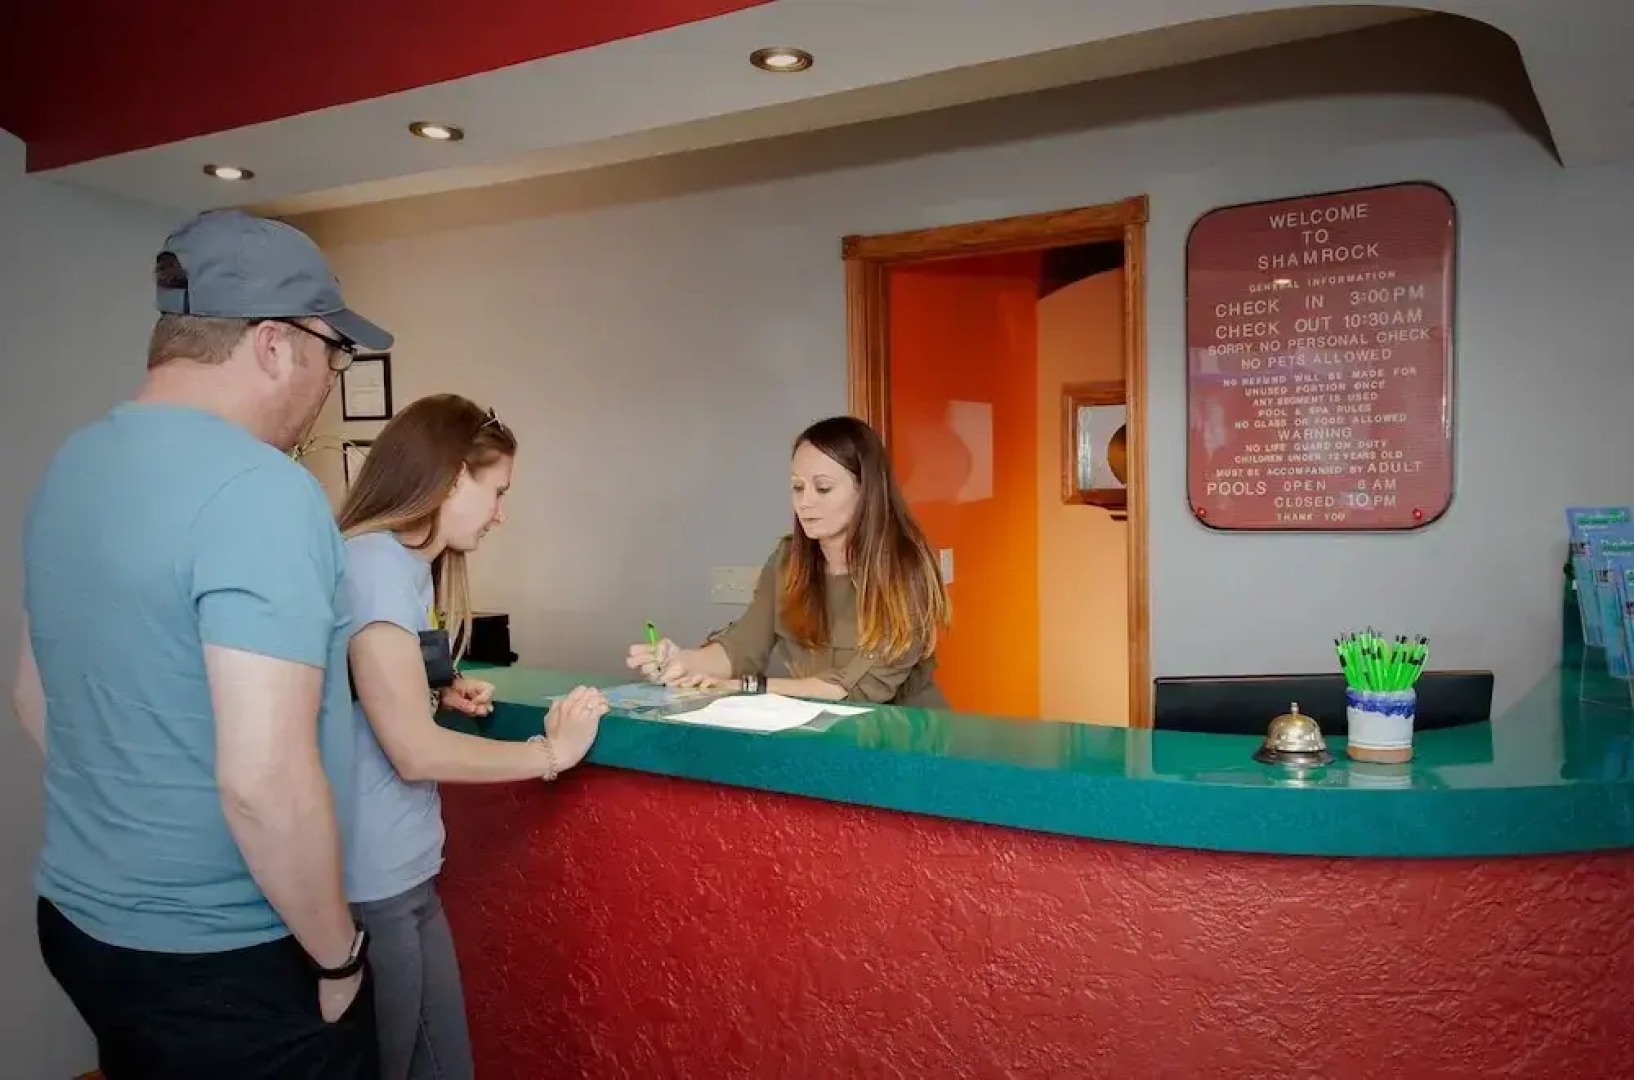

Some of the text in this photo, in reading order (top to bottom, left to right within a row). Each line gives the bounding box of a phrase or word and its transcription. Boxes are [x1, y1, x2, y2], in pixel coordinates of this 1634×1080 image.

[1270, 204, 1368, 229] WELCOME
[1302, 229, 1329, 244] TO
[1257, 244, 1379, 269] SHAMROCK
[1308, 271, 1396, 287] INFORMATION
[1216, 299, 1279, 318] CHECK
[1305, 295, 1324, 309] IN
[1216, 321, 1279, 339] CHECK
[1295, 316, 1332, 333] OUT
[1209, 328, 1430, 356] SORRY NO PERSONAL CHECK
[1241, 348, 1391, 370] NO PETS ALLOWED
[1223, 367, 1416, 387] NO REFUND WILL BE MADE FOR
[1245, 380, 1385, 396] UNUSED PORTION ONCE
[1253, 392, 1378, 407] ANY SEGMENT IS USED
[1258, 407, 1286, 417] POOL
[1309, 405, 1329, 414] SPA
[1336, 403, 1371, 413] RULES
[1235, 413, 1407, 429] NO GLASS OR FOOD ALLOWED
[1278, 427, 1352, 441] WARNING
[1245, 440, 1388, 452] NO LIFE GUARD ON DUTY
[1235, 454, 1284, 464] CHILDREN
[1288, 452, 1321, 462] UNDER
[1343, 451, 1376, 460] YEARS
[1381, 450, 1402, 459] OLD
[1216, 460, 1423, 477] MUST BE ACCOMPANIED BY ADULT
[1207, 481, 1267, 496] POOLS
[1283, 479, 1326, 491] OPEN
[1372, 478, 1396, 490] AM
[1274, 492, 1396, 507] CLOSED 10 PM
[1276, 512, 1346, 521] THANK YOU
